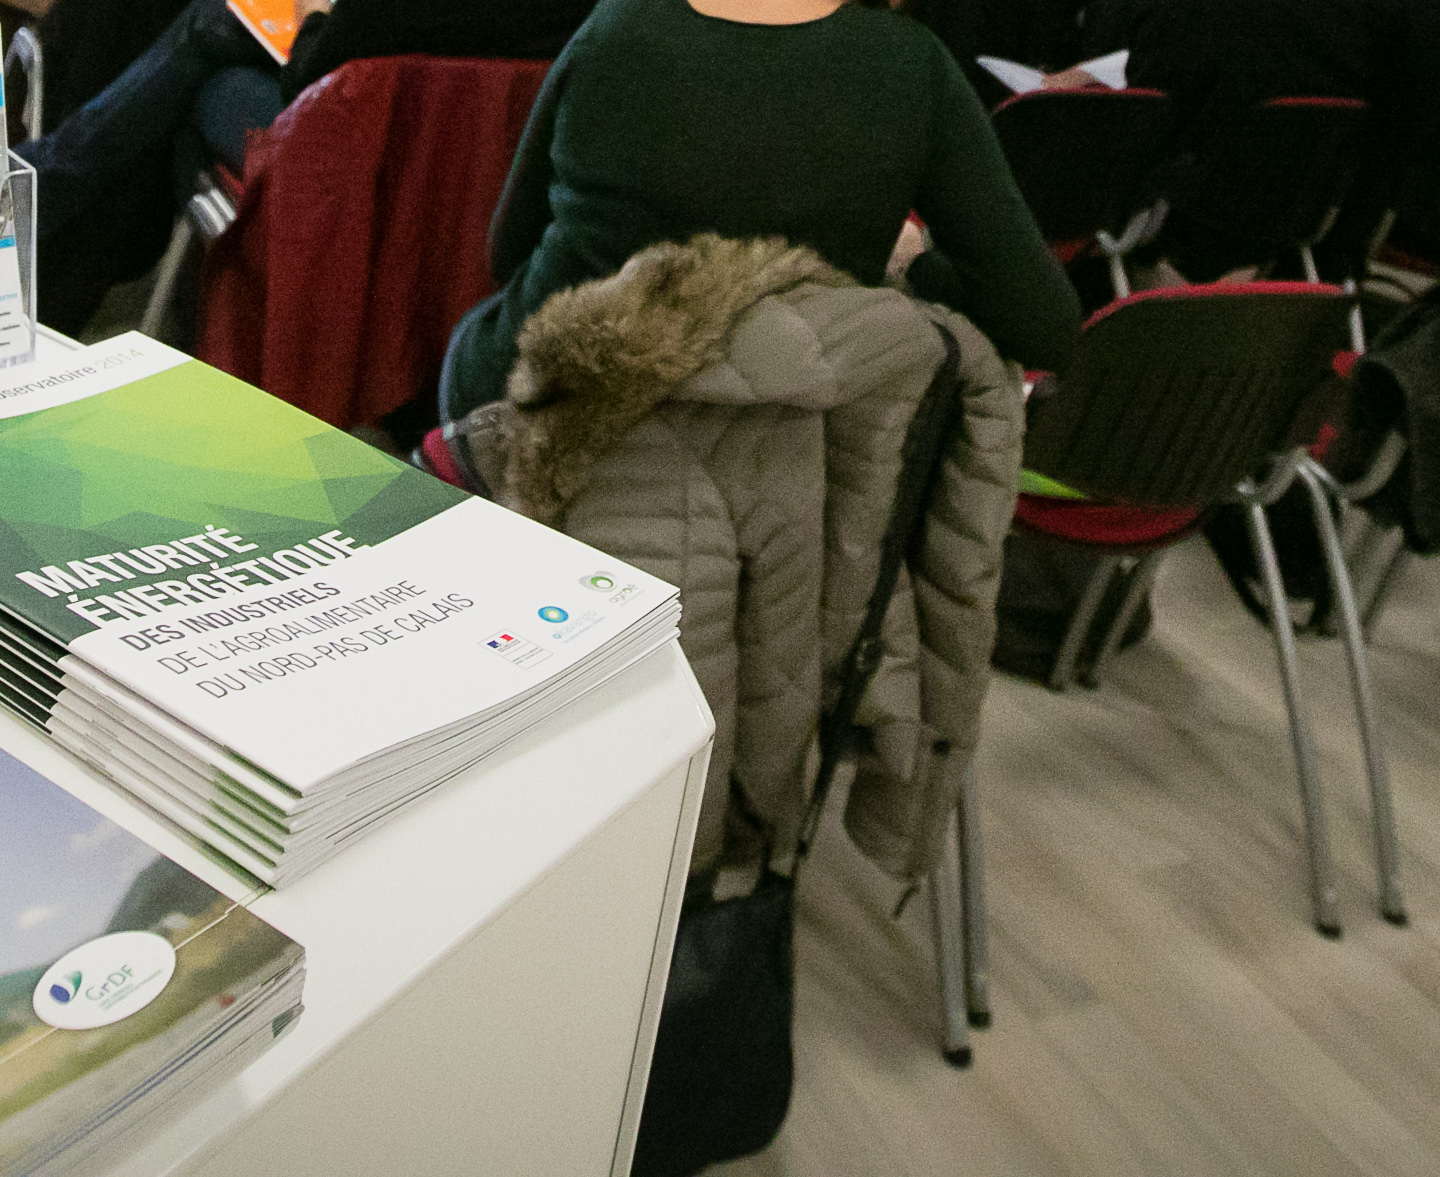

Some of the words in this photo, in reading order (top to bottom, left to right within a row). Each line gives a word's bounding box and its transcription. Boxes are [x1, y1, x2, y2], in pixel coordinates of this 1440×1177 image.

[95, 348, 145, 370] 2014
[15, 524, 259, 599] MATURITÉ
[66, 529, 367, 629] ÉNERGÉTIQUE
[118, 625, 184, 652] DES
[181, 581, 341, 635] INDUSTRIELS
[196, 675, 247, 699] DU
[240, 636, 368, 684] NORD-PAS
[360, 625, 404, 647] DE
[398, 593, 475, 633] CALAIS
[157, 650, 209, 676] DE
[85, 964, 134, 1001] GrDF
